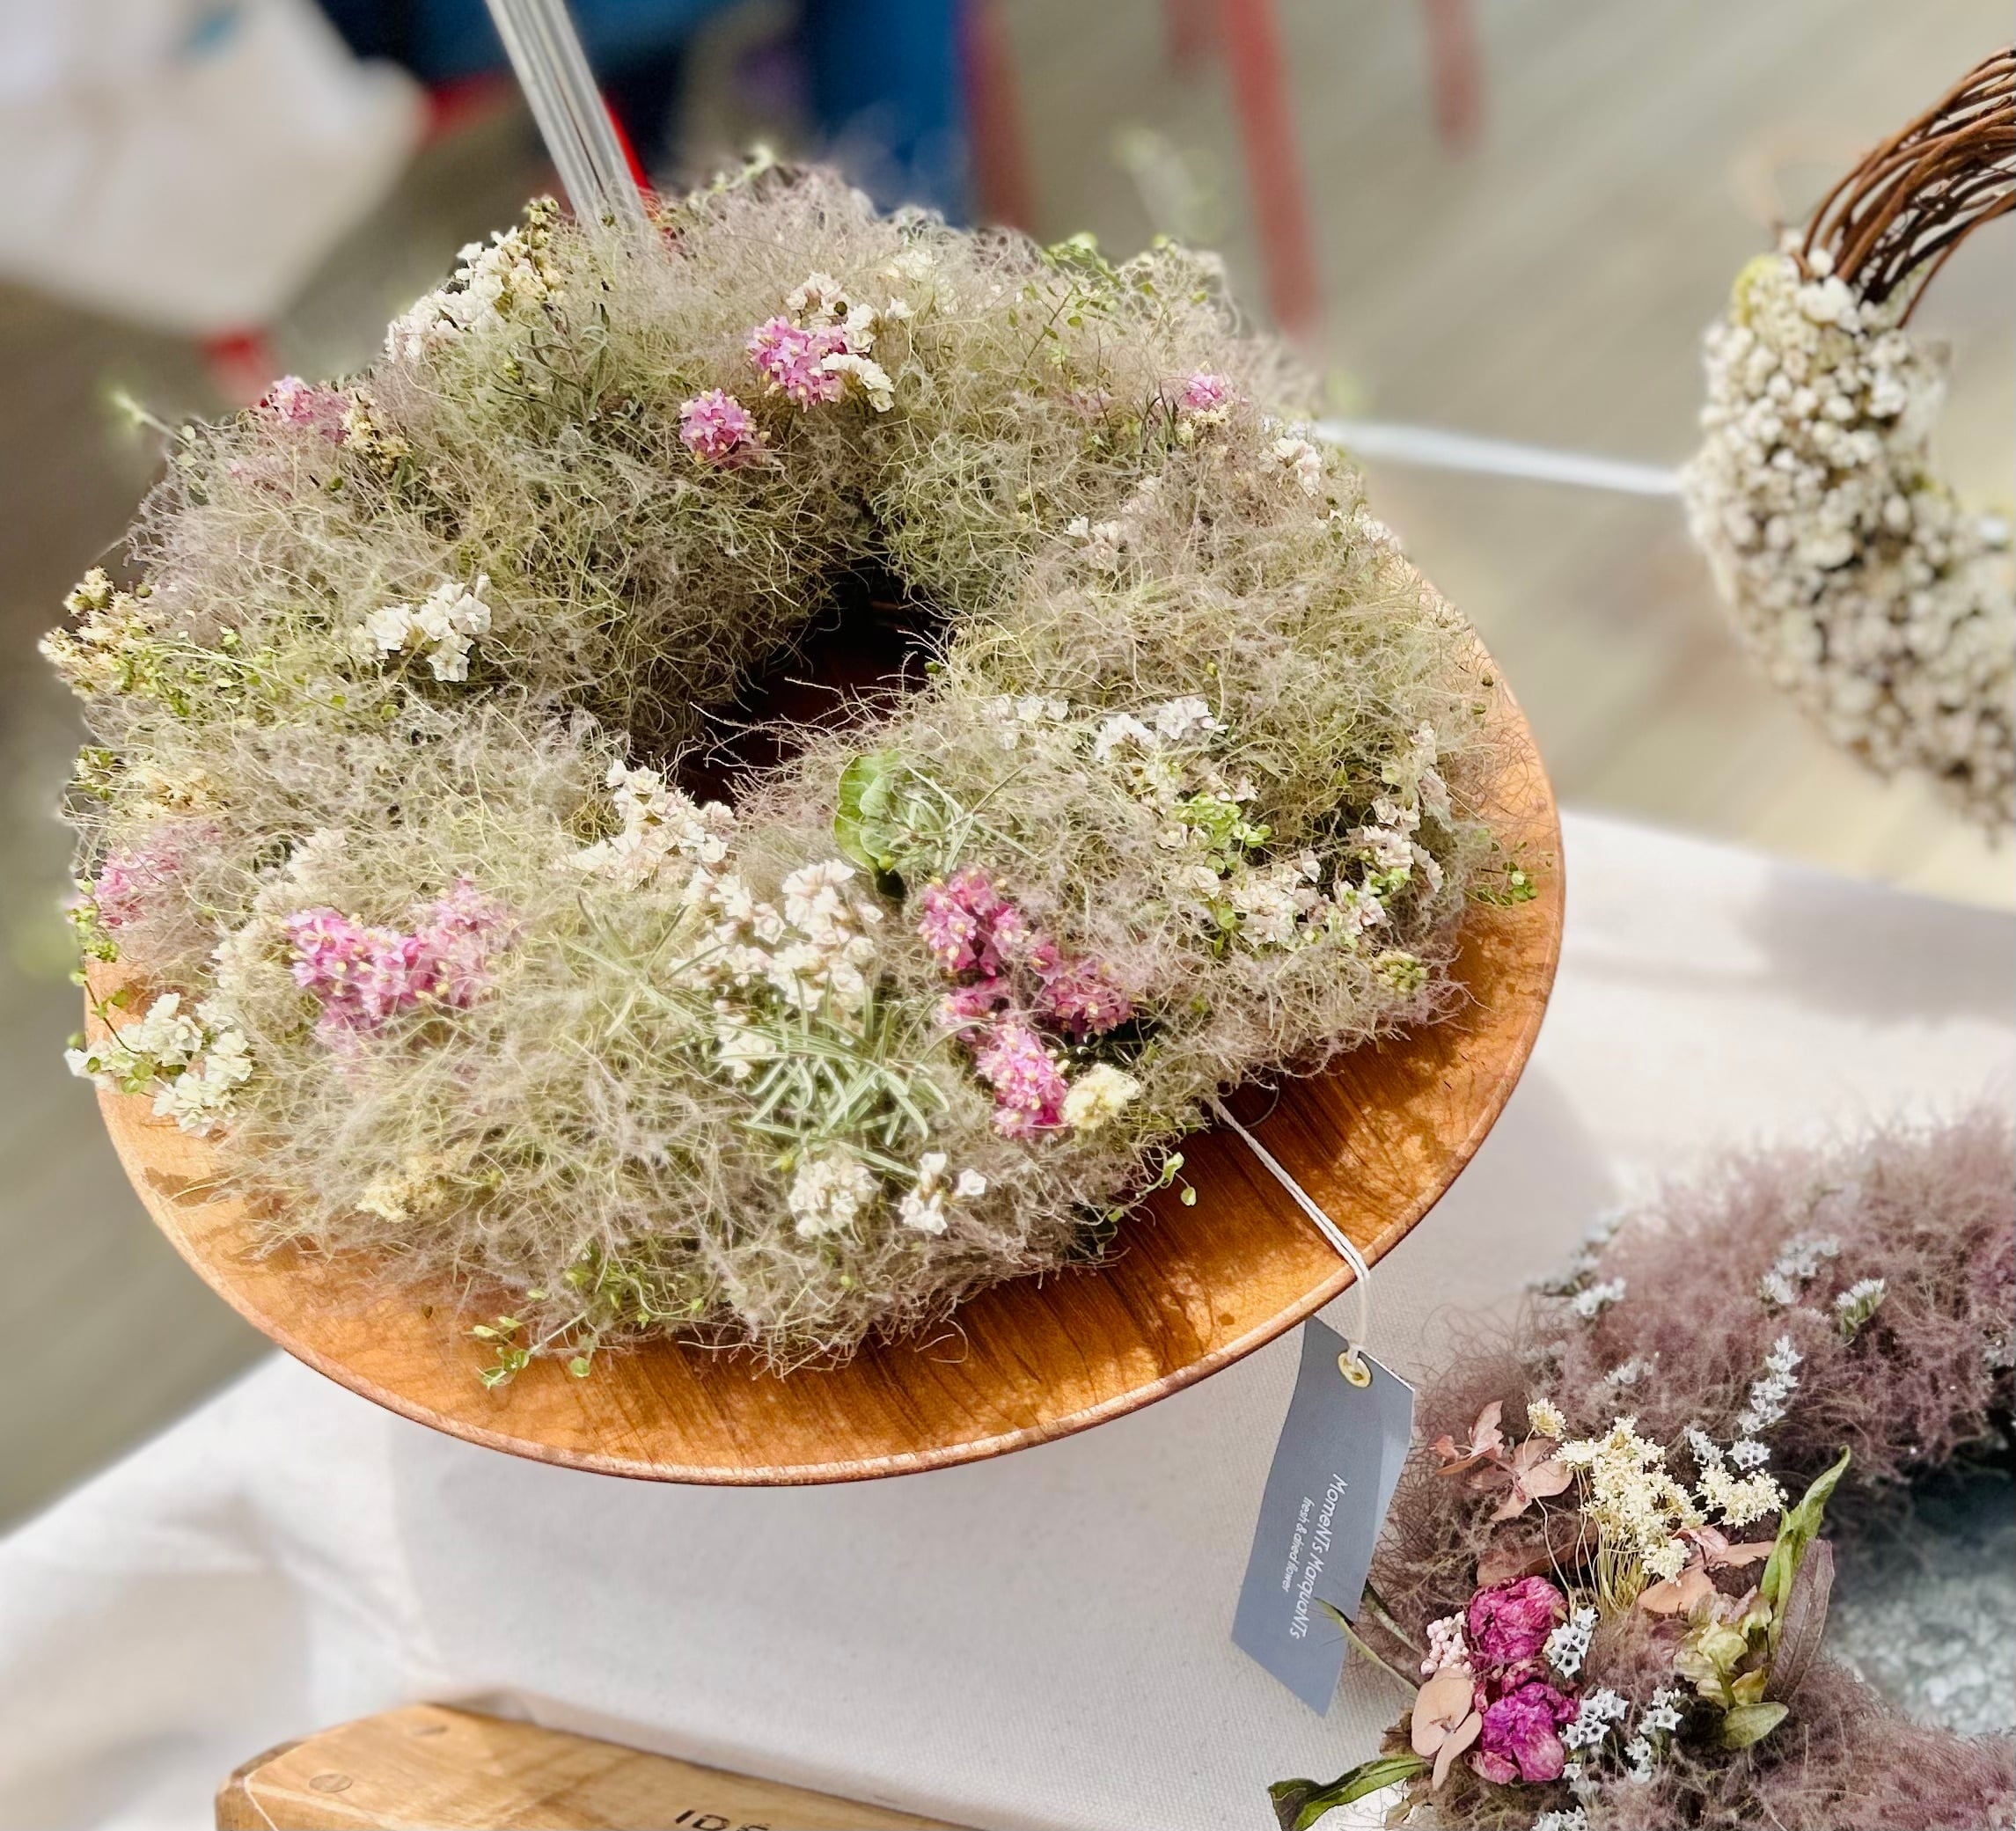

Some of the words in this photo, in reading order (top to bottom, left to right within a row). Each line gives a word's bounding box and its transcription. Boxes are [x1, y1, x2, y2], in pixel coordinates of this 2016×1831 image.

[1298, 1497, 1315, 1523] fresh
[1312, 1474, 1348, 1553] MomeNTs
[1295, 1523, 1308, 1534] &
[1288, 1533, 1304, 1564] dried
[1281, 1561, 1298, 1593] flower
[1289, 1552, 1324, 1639] MarquaNTs
